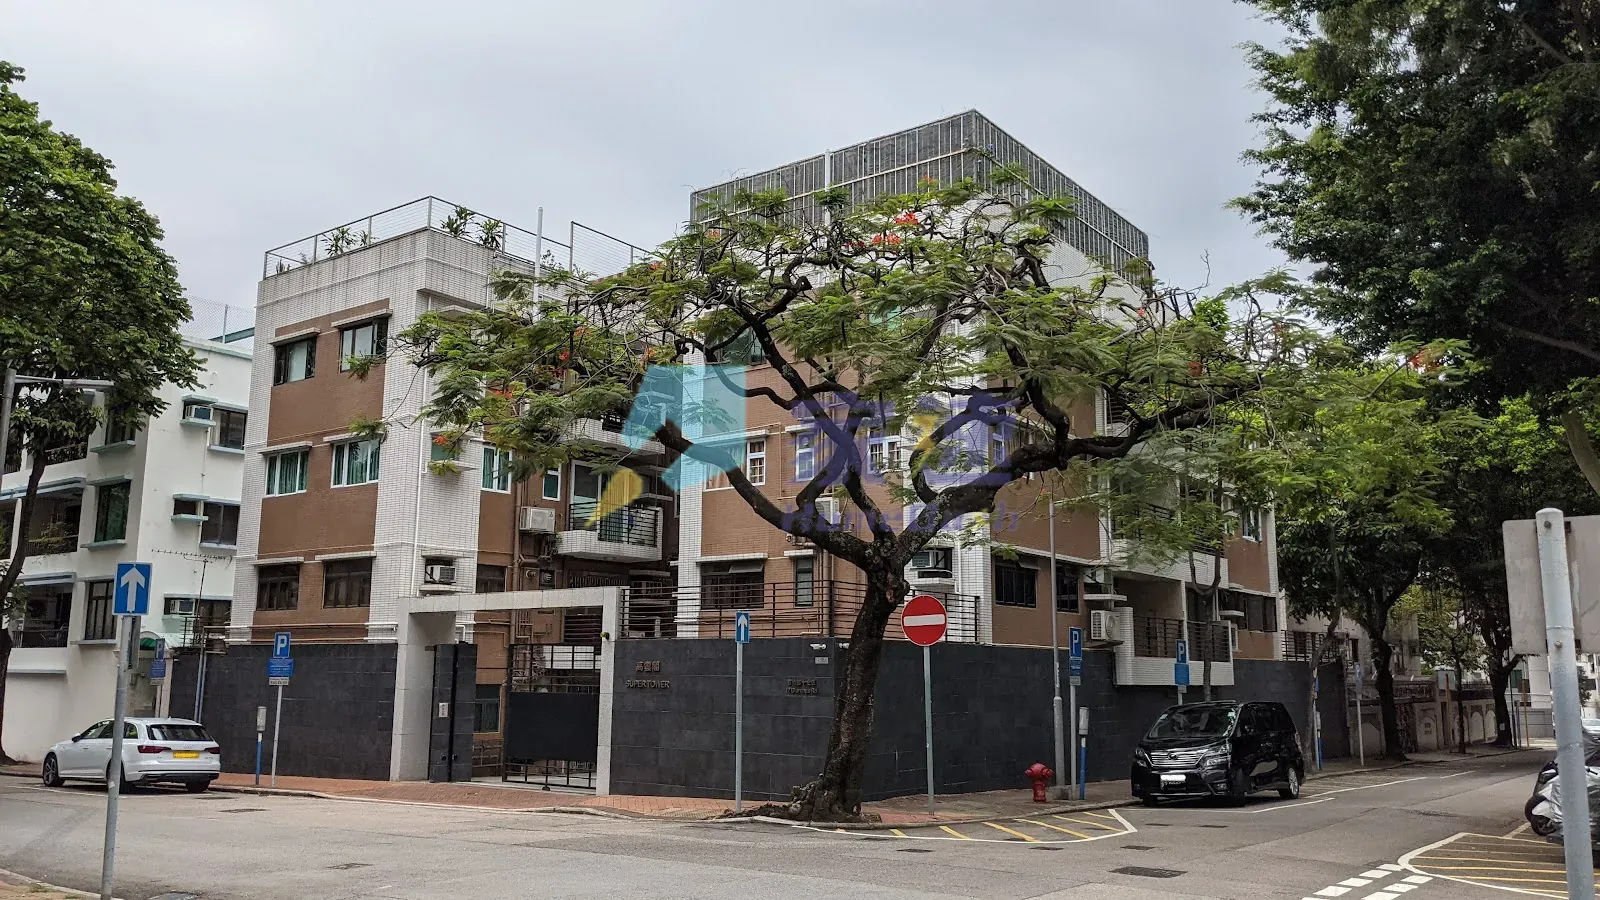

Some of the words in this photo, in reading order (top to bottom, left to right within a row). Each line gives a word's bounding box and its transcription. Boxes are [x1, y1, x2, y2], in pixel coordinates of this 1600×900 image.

[277, 635, 287, 656] P
[1072, 630, 1079, 655] P
[1178, 642, 1184, 661] P
